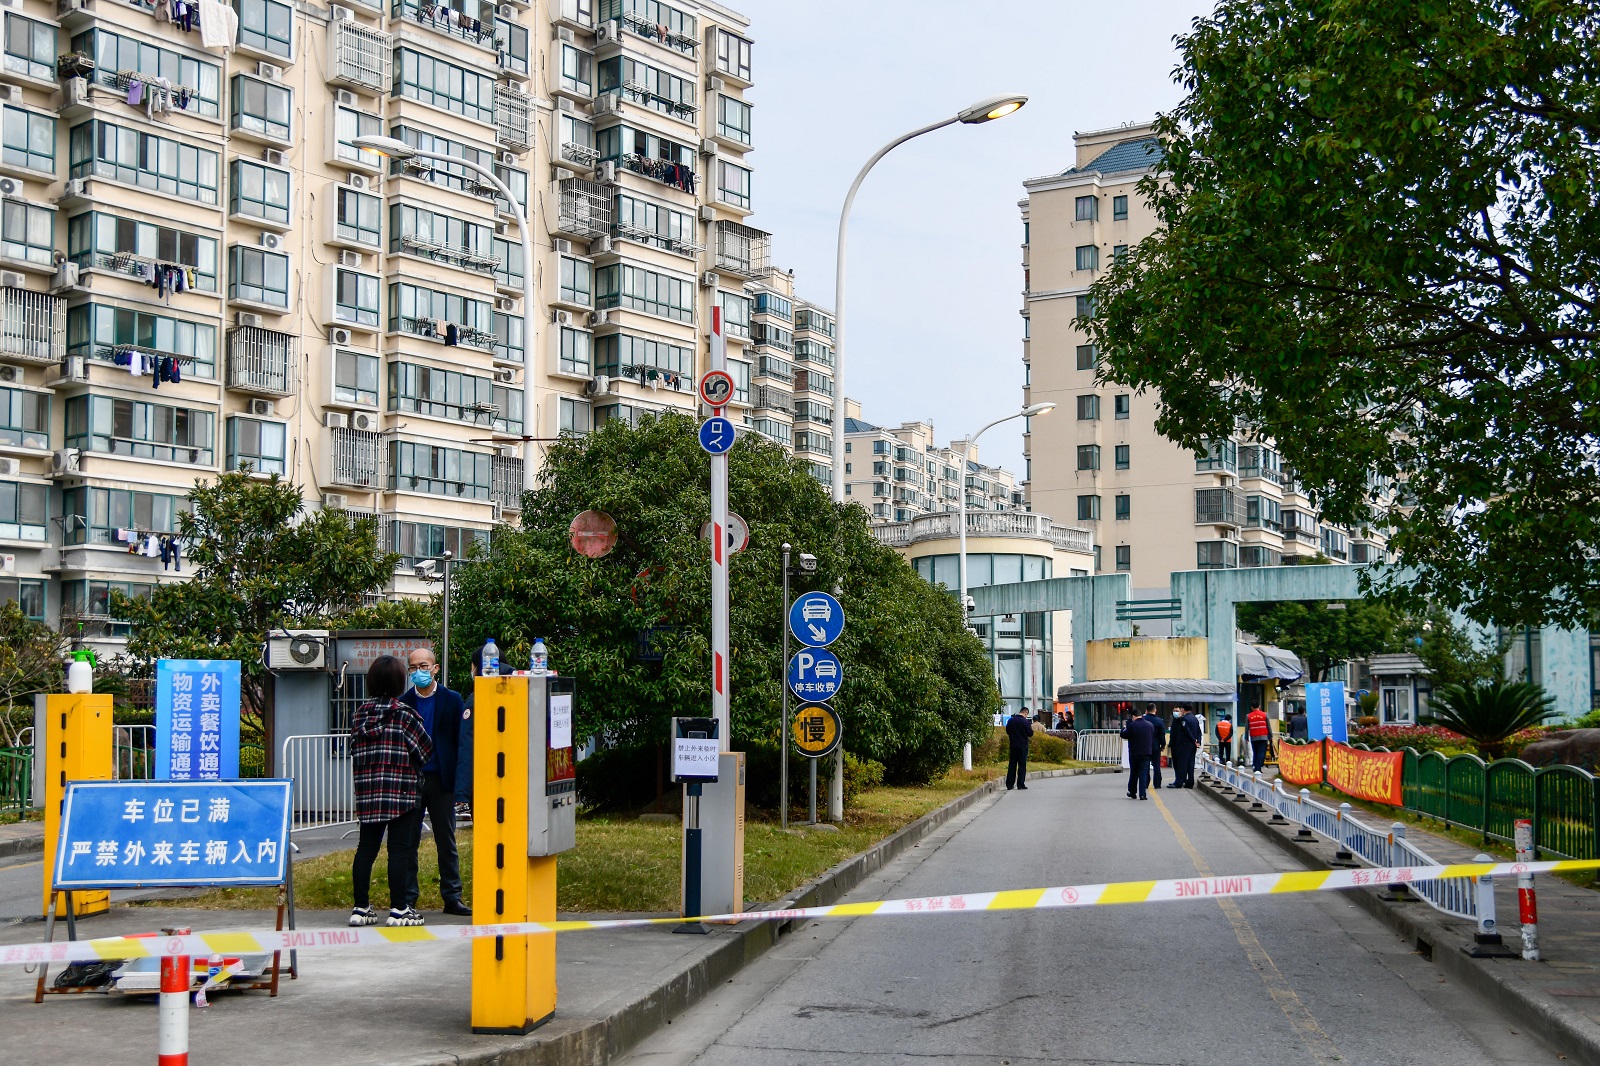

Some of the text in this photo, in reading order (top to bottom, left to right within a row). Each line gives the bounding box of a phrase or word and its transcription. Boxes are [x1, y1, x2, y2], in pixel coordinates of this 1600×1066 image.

[705, 380, 729, 395] 5
[709, 421, 723, 449] 入口
[798, 653, 814, 680] P
[795, 682, 835, 693] 停车收费
[1320, 688, 1333, 739] 防护服脱卸
[800, 716, 826, 743] 慢
[677, 745, 716, 753] 禁止外来临时
[677, 754, 716, 762] 车辆进入小区
[122, 797, 231, 824] 车位已满
[68, 838, 278, 867] 严禁外来车辆入内
[1174, 877, 1252, 897] LIMIT LINE
